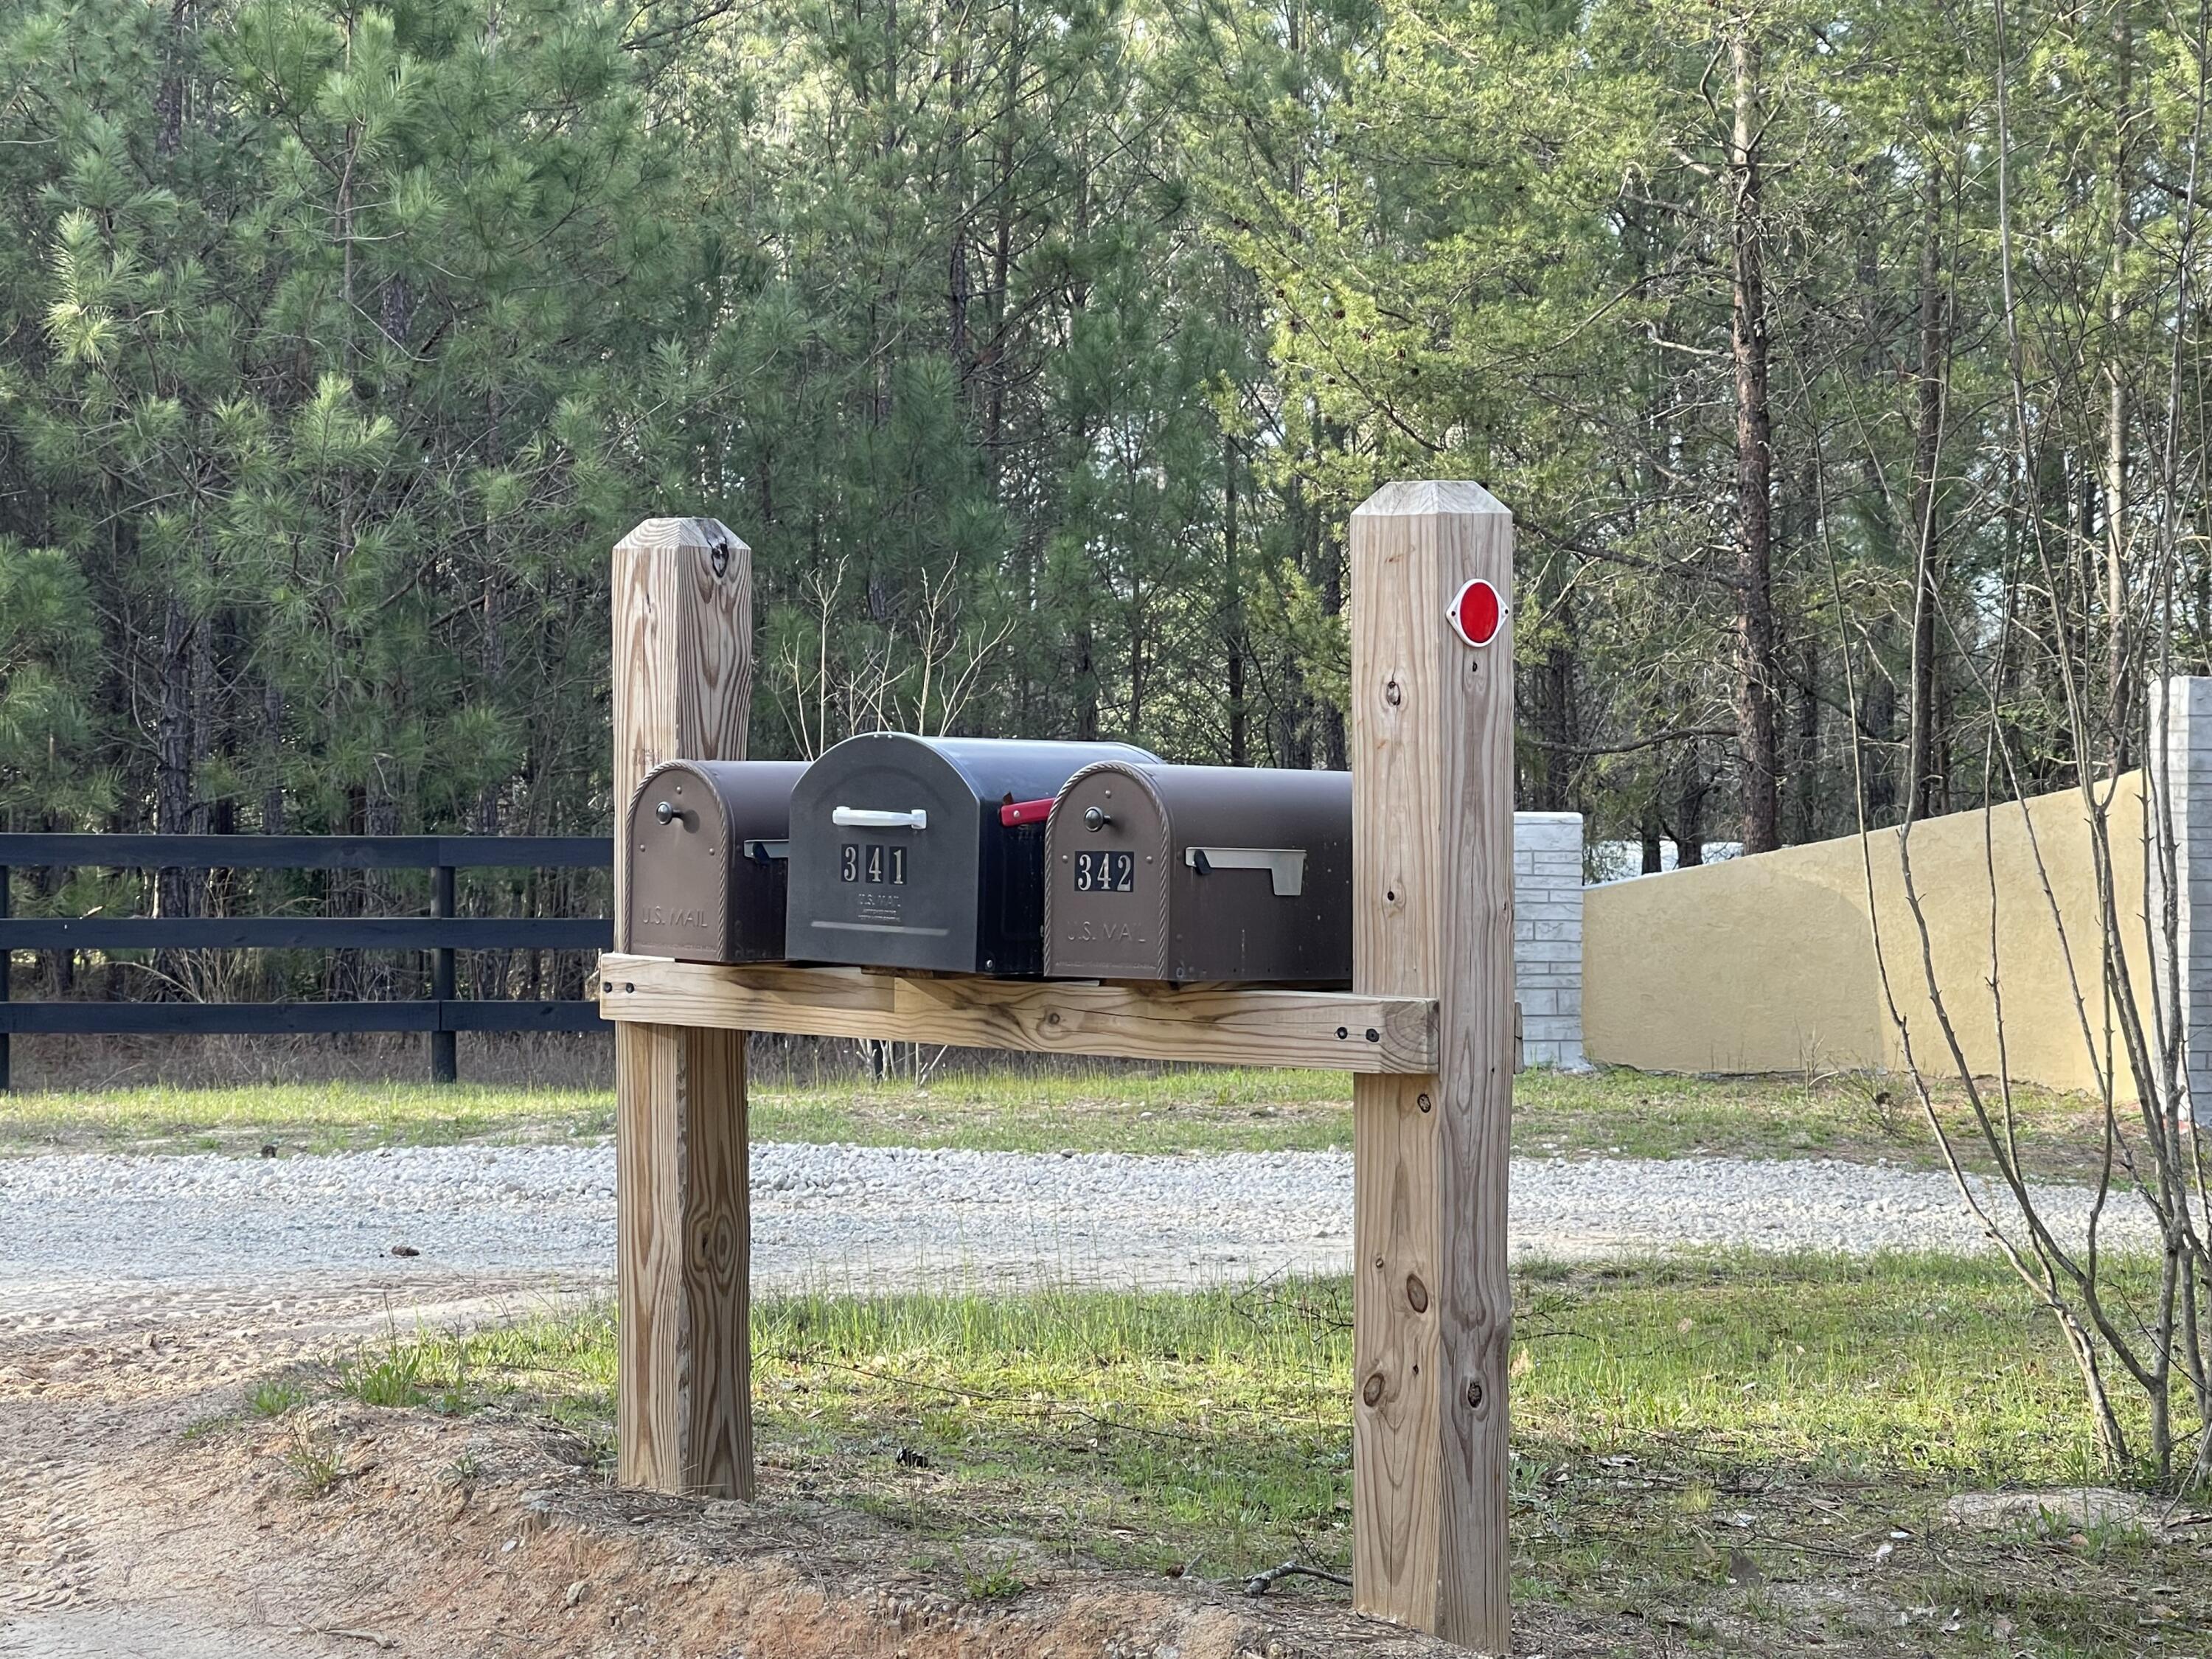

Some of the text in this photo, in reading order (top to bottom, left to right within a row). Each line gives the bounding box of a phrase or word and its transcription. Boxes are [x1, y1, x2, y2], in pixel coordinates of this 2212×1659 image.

[844, 846, 903, 884] 341
[1077, 853, 1132, 891] 342
[641, 905, 708, 928] U.S. MAIL
[1103, 922, 1147, 943] MAL
